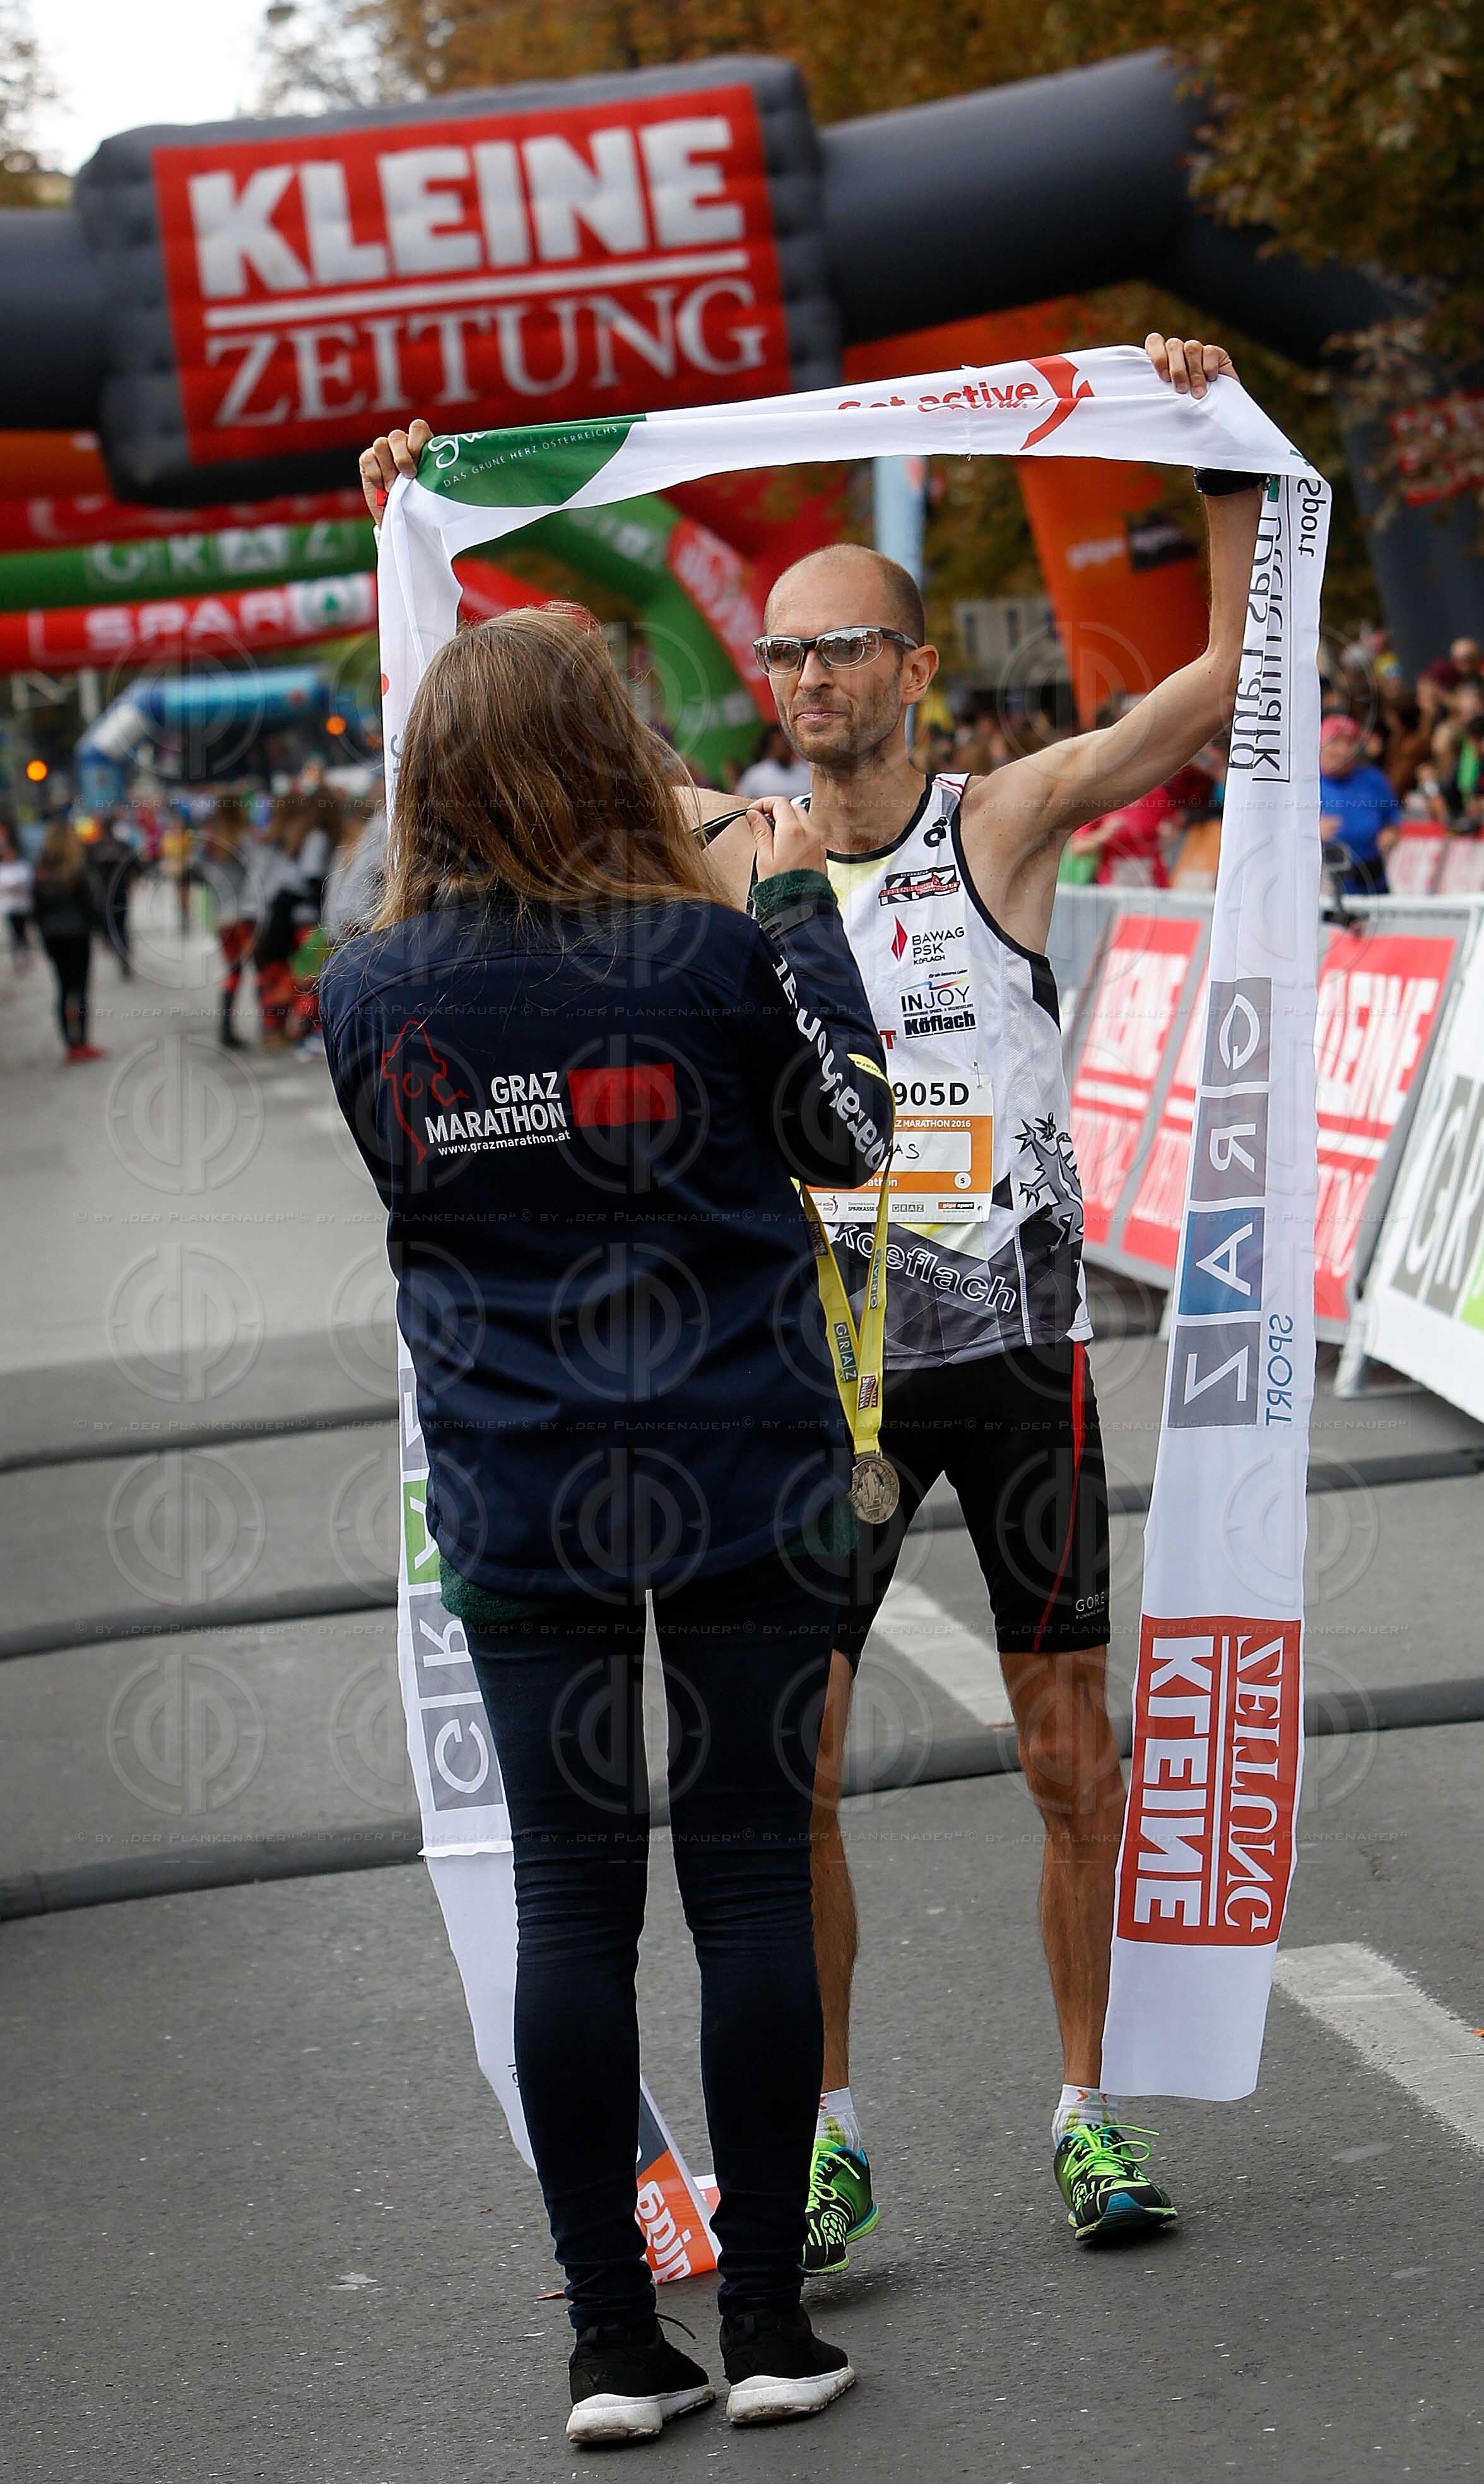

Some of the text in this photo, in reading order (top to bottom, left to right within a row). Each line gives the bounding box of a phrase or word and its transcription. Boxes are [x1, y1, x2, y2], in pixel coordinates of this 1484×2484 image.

[187, 115, 745, 300] KLEINE
[206, 278, 767, 428] ZEITUNG
[510, 445, 538, 461] HERZ
[912, 926, 965, 946] BAWAG
[913, 943, 945, 957] PSK
[900, 985, 970, 1012] INJOY
[904, 1010, 976, 1036] Köflach
[490, 1071, 561, 1105] GRAZ
[425, 1102, 567, 1144] MARATHON
[903, 1120, 950, 1128] MARATHON
[951, 1119, 971, 1128] 2016
[438, 1130, 571, 1156] www.grazmarathon.at
[835, 1323, 857, 1381] GRAZ
[1075, 1591, 1105, 1612] GORE
